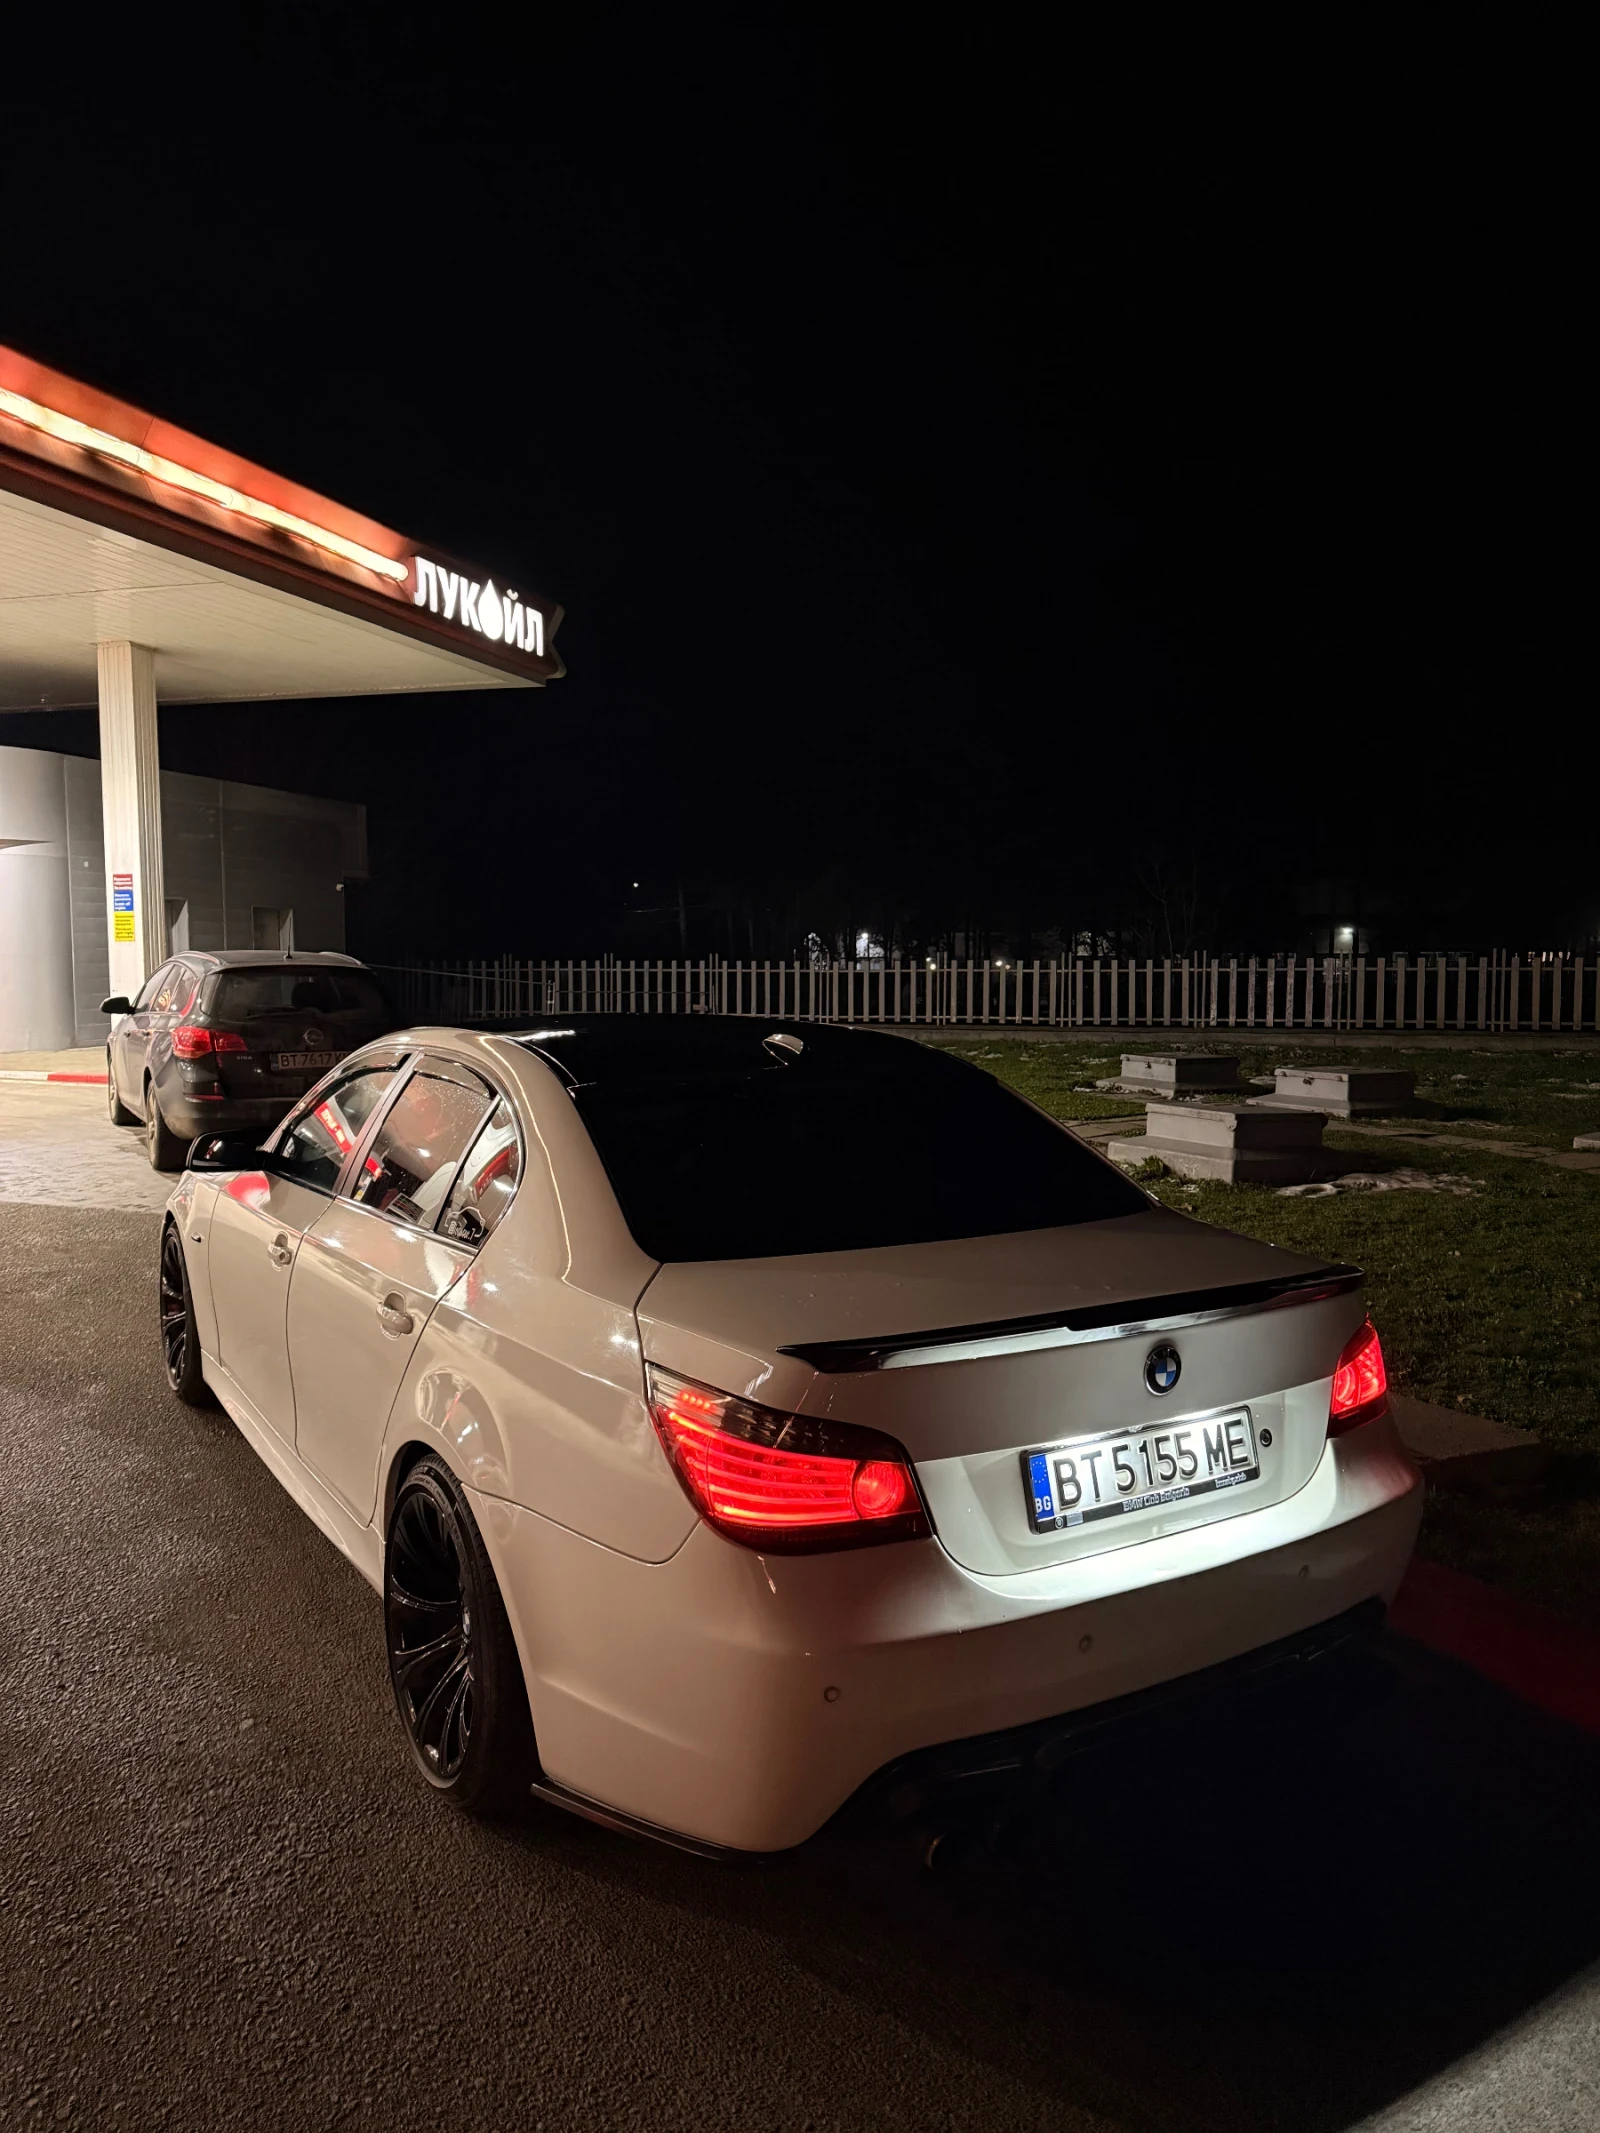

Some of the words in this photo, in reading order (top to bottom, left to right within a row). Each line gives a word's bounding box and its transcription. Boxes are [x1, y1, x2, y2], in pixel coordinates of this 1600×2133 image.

[280, 1054, 298, 1067] BT
[1054, 1450, 1102, 1508] BT
[1111, 1431, 1198, 1493] 5155
[1203, 1419, 1248, 1474] ME
[1035, 1495, 1052, 1512] BG
[1123, 1498, 1144, 1512] BMW
[1144, 1493, 1160, 1506] Club
[1160, 1486, 1191, 1502] Bulgaria
